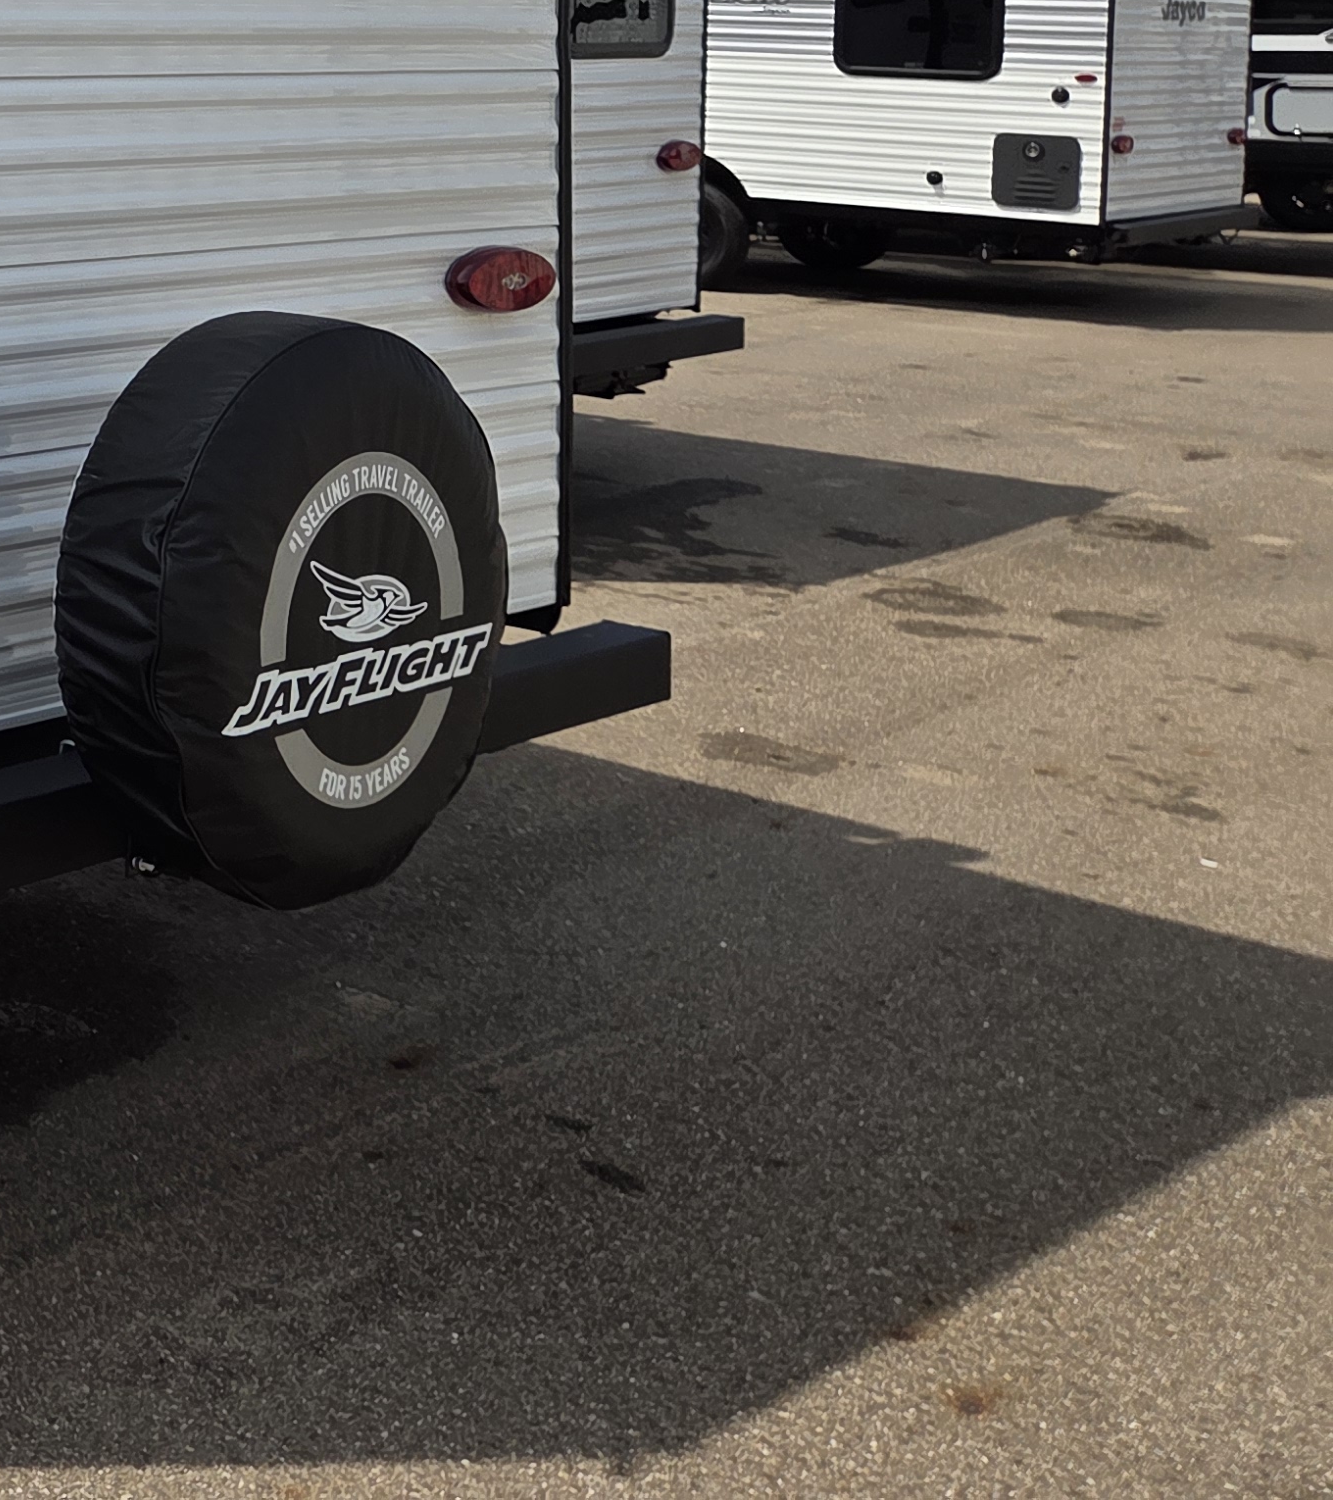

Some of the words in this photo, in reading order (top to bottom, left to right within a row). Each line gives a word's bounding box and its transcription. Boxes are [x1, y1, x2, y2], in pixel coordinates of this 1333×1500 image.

[287, 530, 306, 553] #1
[300, 474, 351, 537] SELLING
[352, 464, 398, 493] TRAVEL
[402, 473, 447, 539] TRAILER
[223, 666, 328, 736] JAY
[320, 623, 491, 713] FLIGHT
[318, 766, 347, 800] FOR
[348, 777, 363, 800] 15
[365, 746, 411, 799] YEARS
